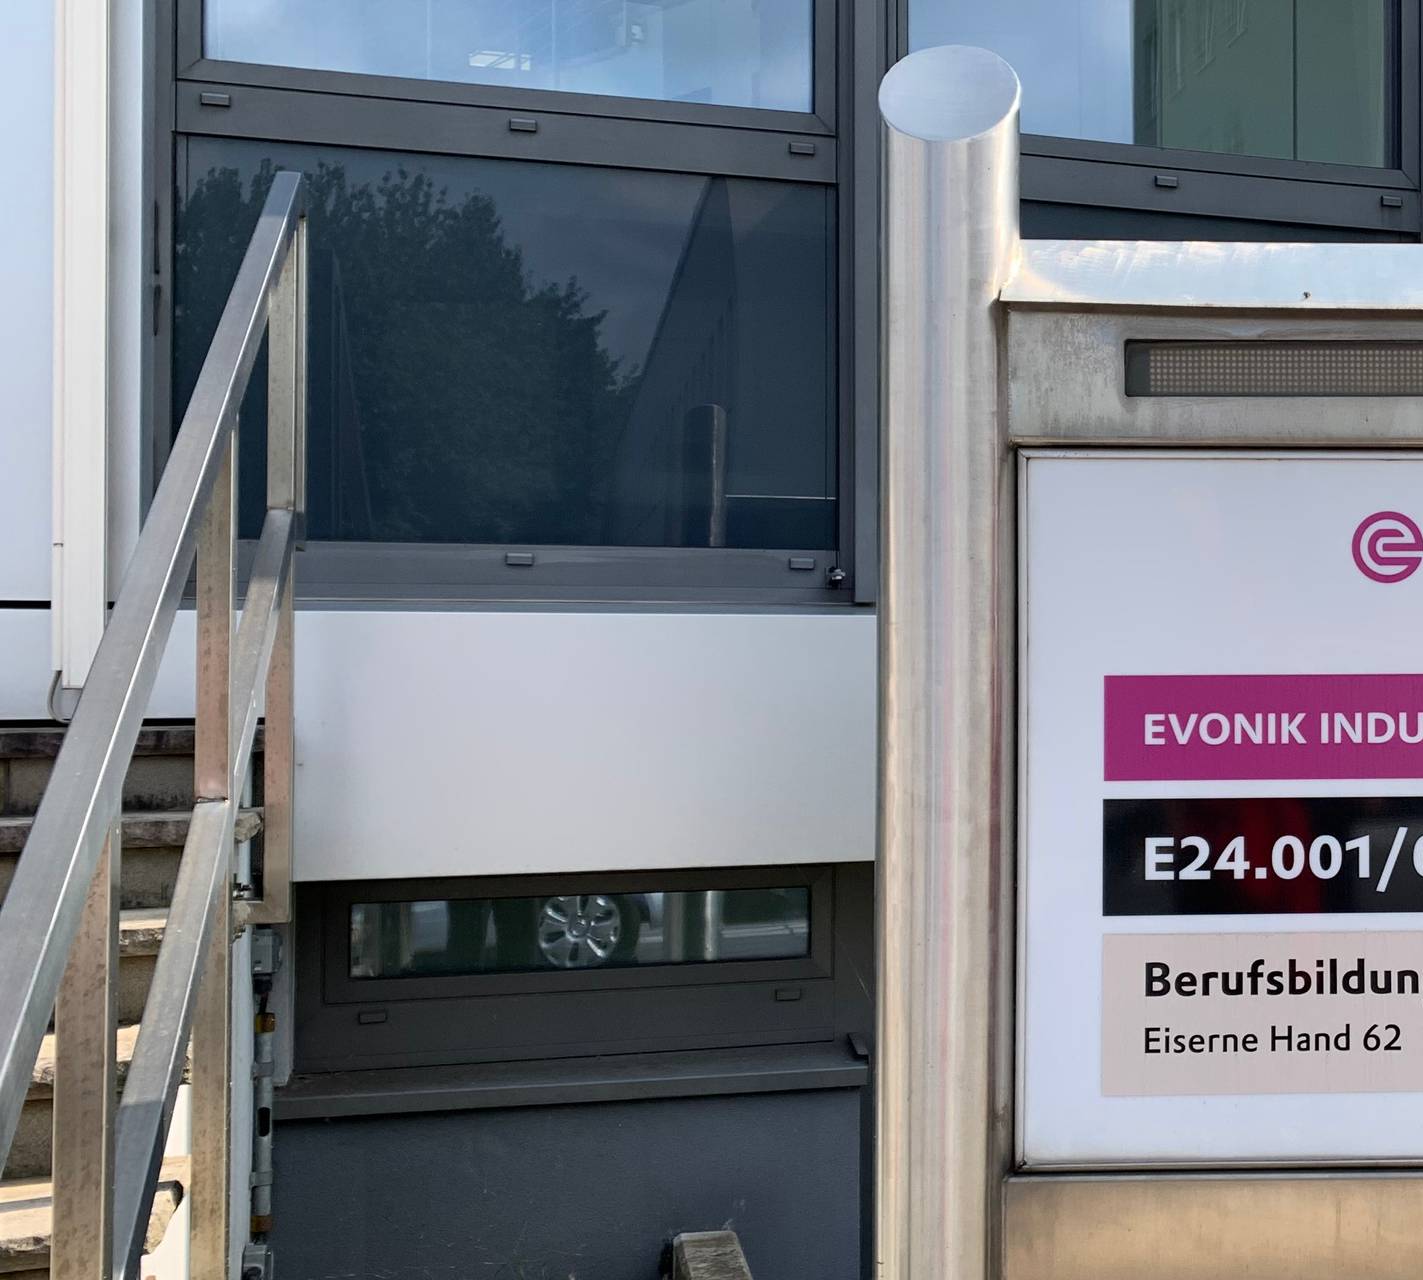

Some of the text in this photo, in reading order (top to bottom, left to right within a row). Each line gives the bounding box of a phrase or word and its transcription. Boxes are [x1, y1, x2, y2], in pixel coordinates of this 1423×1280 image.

[1144, 712, 1307, 745] EVONIK
[1144, 1023, 1402, 1054] Eiserne Hand 62
